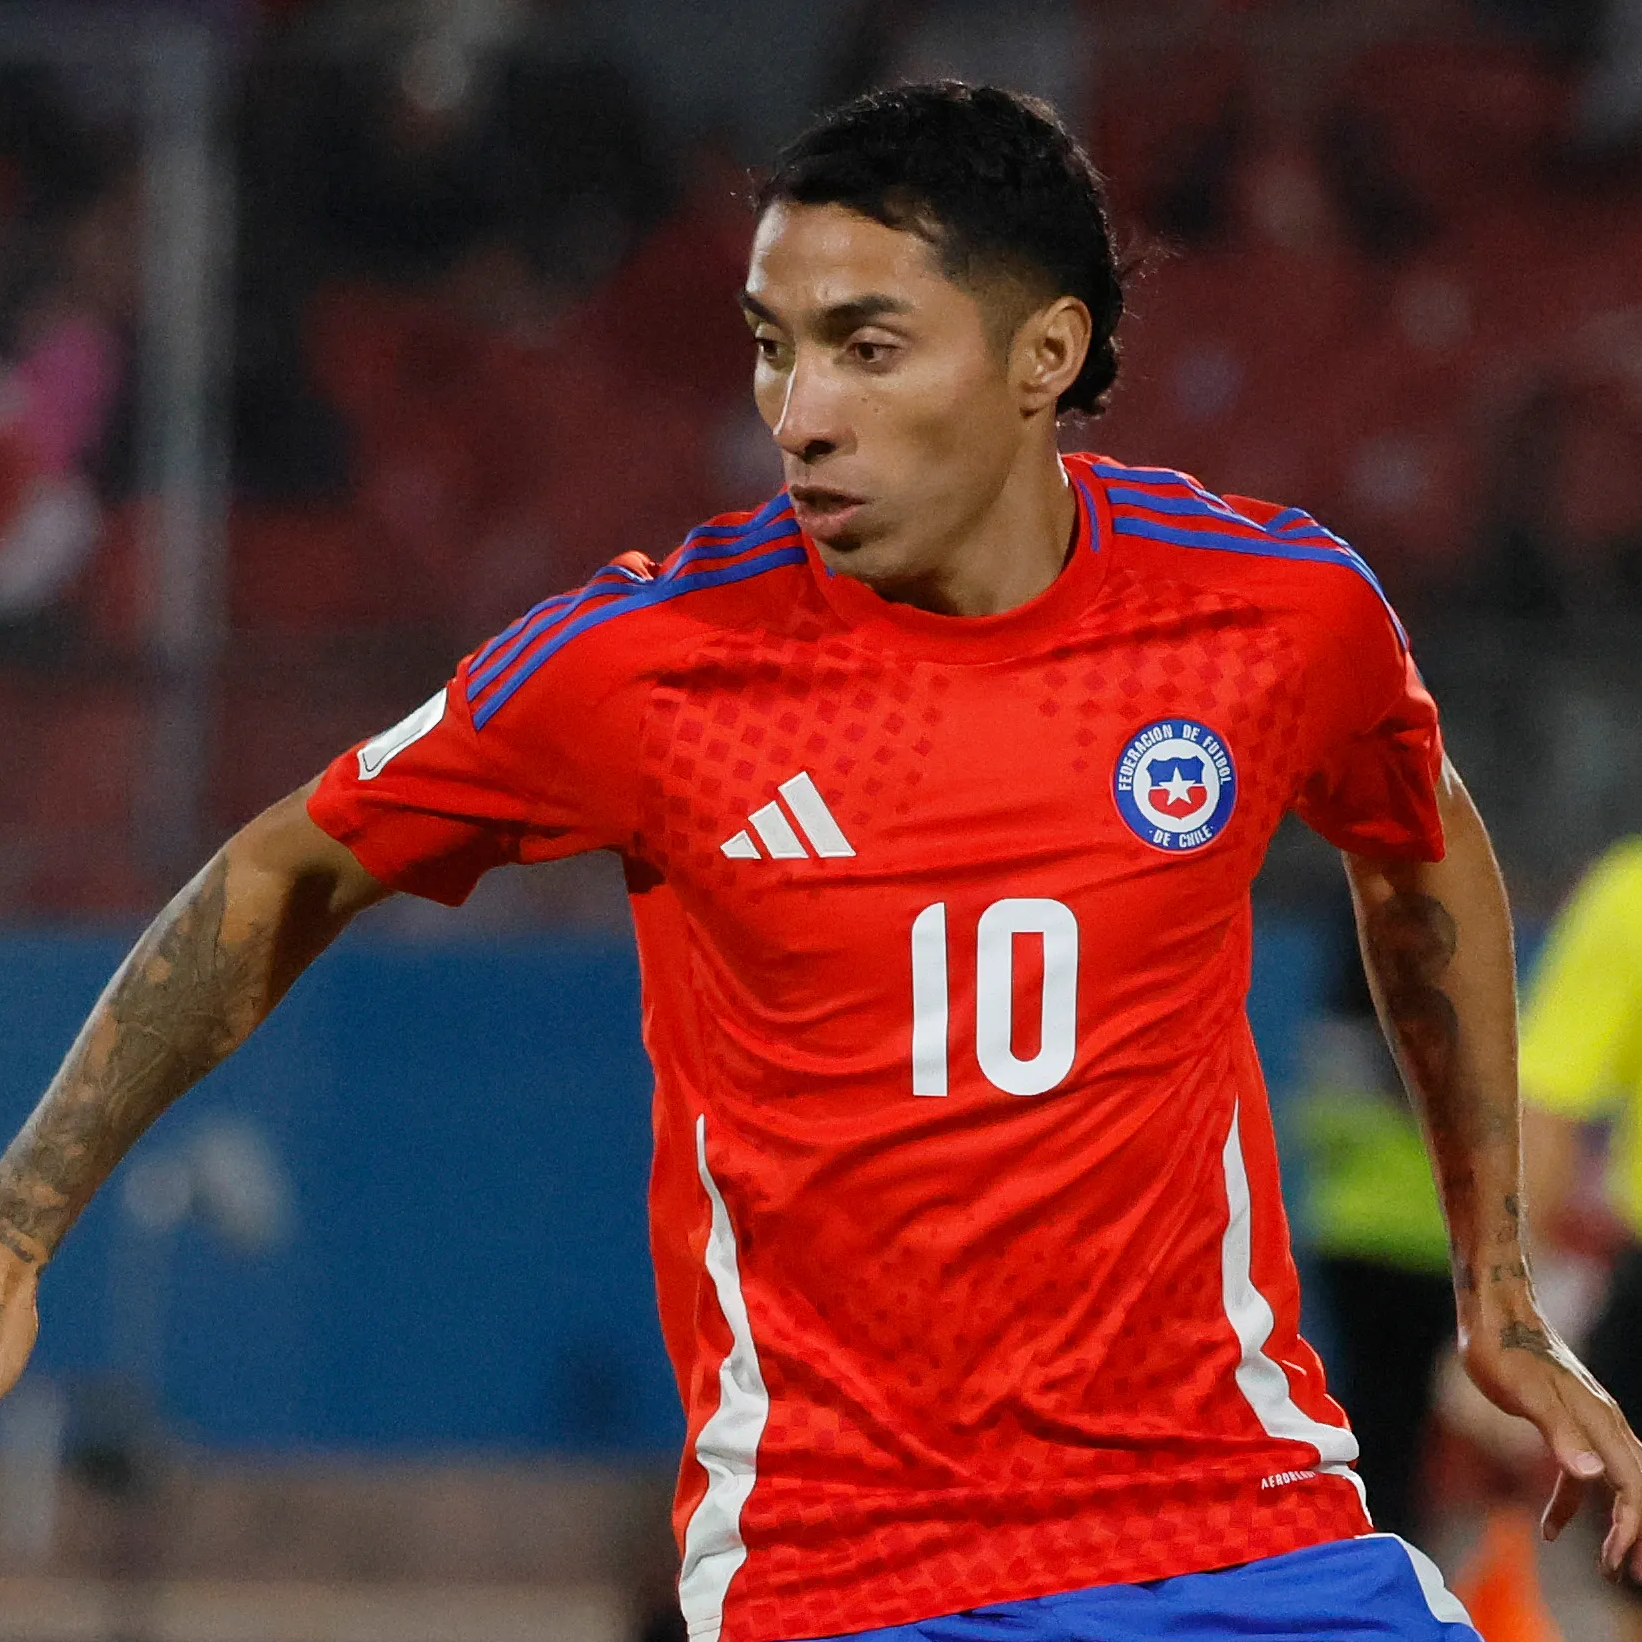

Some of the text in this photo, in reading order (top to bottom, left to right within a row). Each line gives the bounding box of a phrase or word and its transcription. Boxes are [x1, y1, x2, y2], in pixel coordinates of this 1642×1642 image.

[1119, 724, 1232, 791] FEDERACION DE FUTBOL
[1153, 825, 1213, 848] DE CHILE
[911, 897, 1079, 1096] 10
